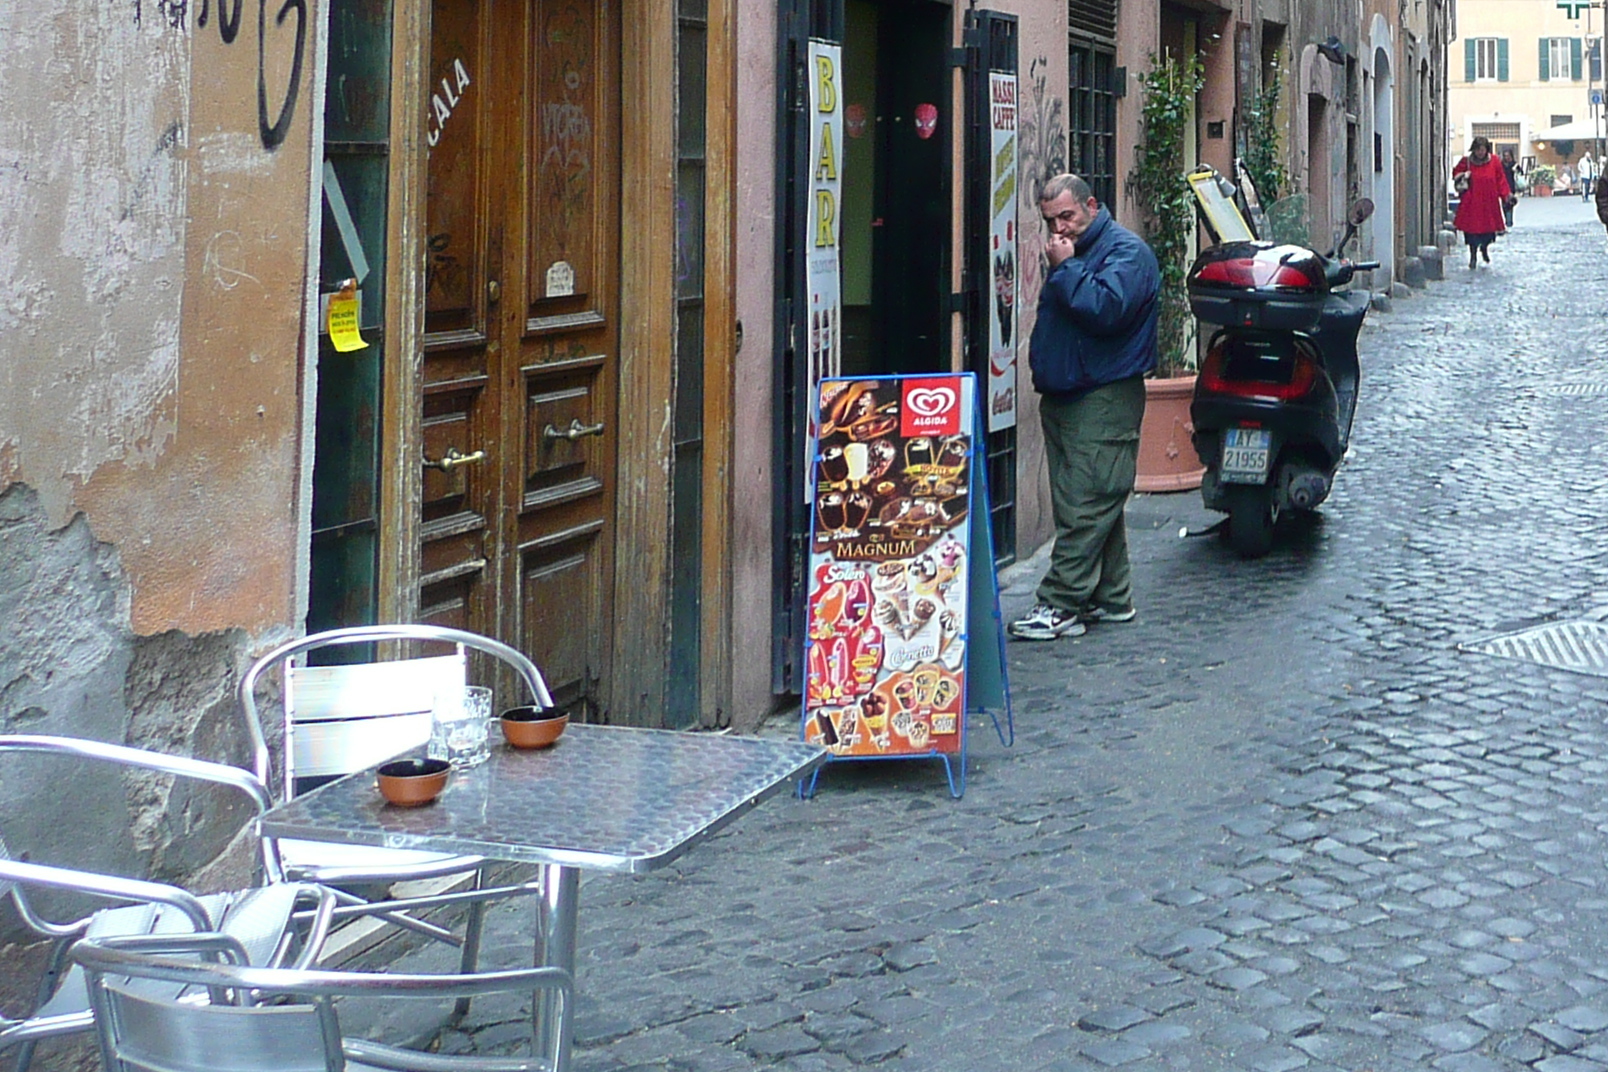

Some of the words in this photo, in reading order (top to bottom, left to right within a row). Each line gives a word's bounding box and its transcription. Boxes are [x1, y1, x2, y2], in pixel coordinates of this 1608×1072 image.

[991, 79, 1015, 105] MASSI
[815, 55, 837, 248] BAR
[913, 416, 948, 426] ALGIDA
[1224, 450, 1267, 470] 21955
[836, 538, 916, 558] MAGNUM
[823, 566, 866, 584] Solero
